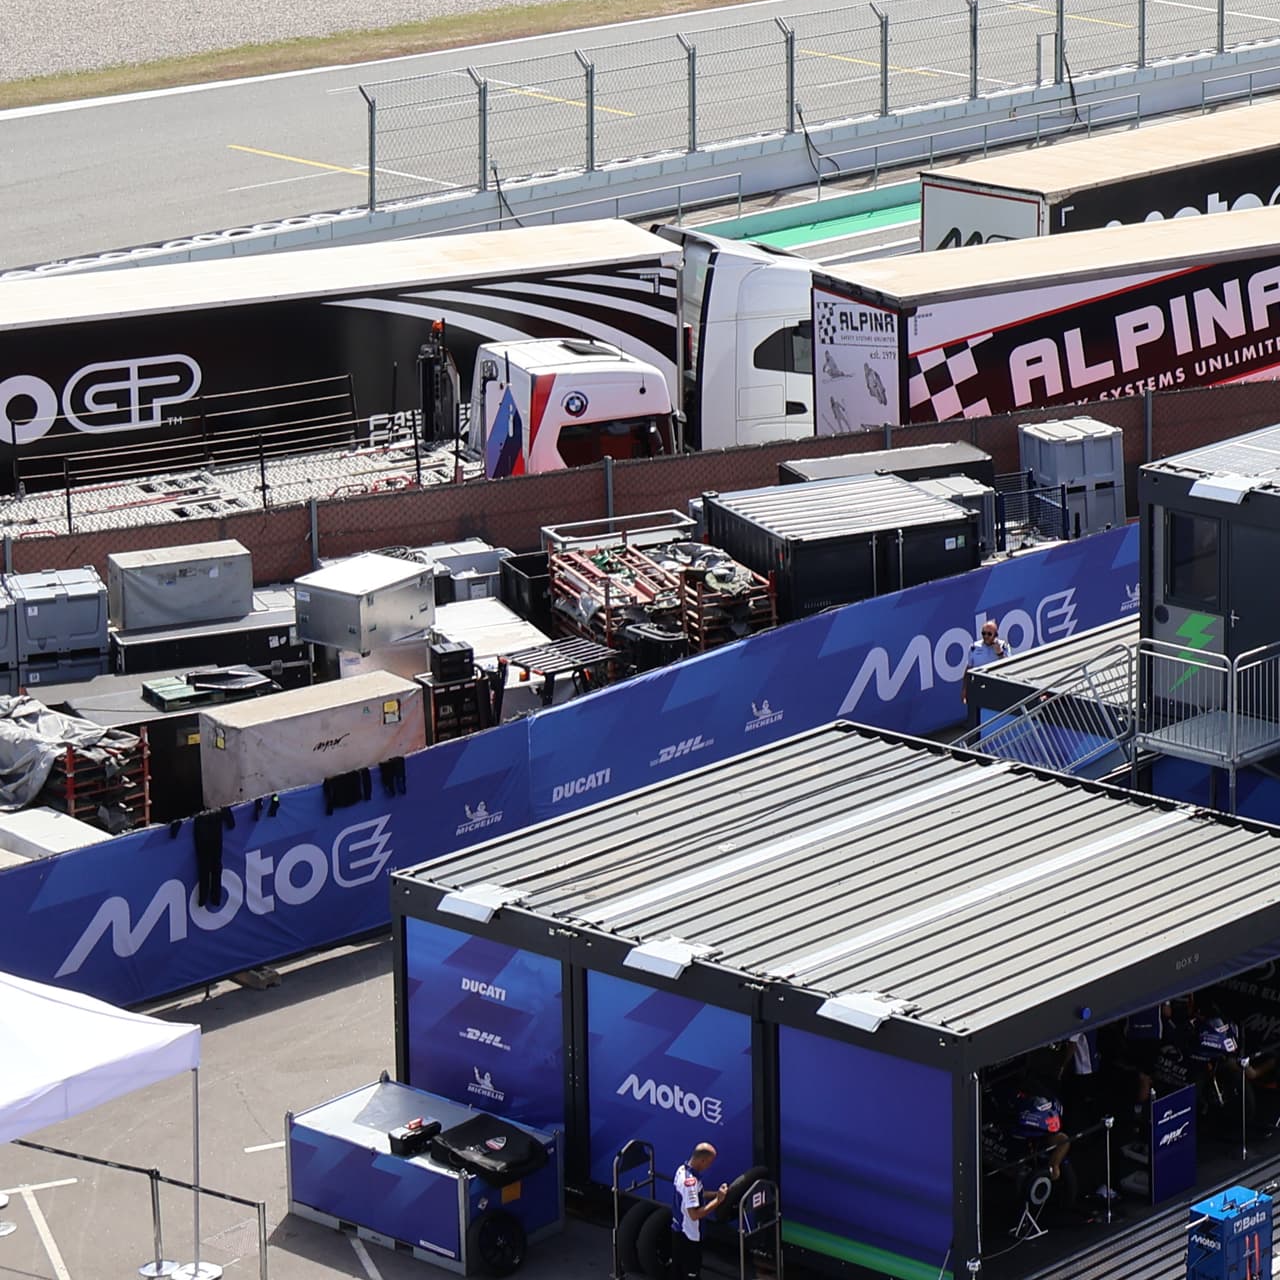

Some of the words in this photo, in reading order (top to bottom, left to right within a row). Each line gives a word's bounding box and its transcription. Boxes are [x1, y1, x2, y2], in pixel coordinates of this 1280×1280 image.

[840, 310, 895, 334] ALPINA
[745, 712, 783, 732] MICHELIN
[659, 735, 703, 762] DHL
[552, 768, 611, 803] DUCATI
[456, 813, 503, 836] MICHELIN
[54, 816, 393, 980] MotoE
[461, 978, 506, 1002] DUCATI
[466, 1027, 504, 1048] DHL
[467, 1082, 505, 1102] MICHELIN
[616, 1073, 722, 1124] MotoE
[1242, 1211, 1267, 1231] Beta
